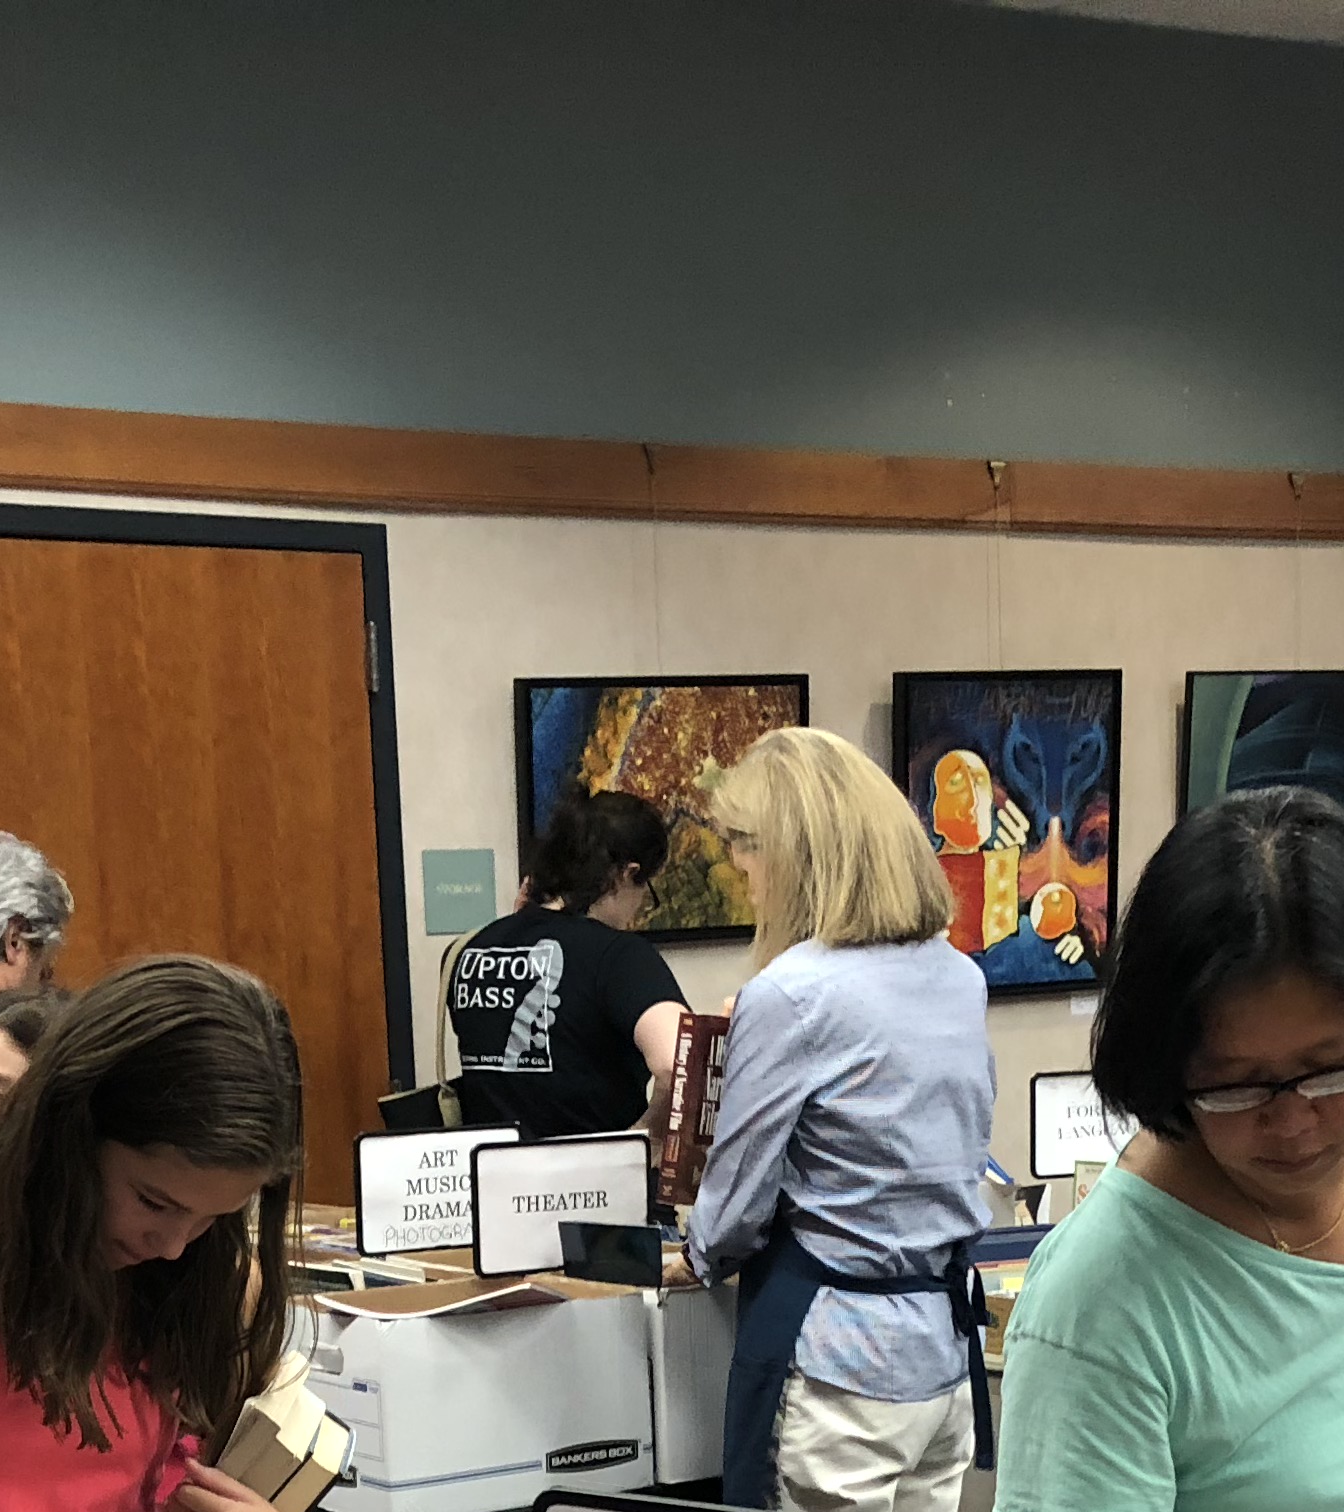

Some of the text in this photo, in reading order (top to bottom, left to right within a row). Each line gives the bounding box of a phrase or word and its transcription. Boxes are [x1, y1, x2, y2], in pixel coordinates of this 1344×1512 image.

[461, 952, 548, 981] UPTON
[457, 983, 515, 1010] BASS
[419, 1150, 458, 1170] ART
[406, 1175, 471, 1197] MUSIC
[403, 1201, 472, 1223] DRAMA
[512, 1190, 609, 1215] THEATER
[551, 1444, 634, 1468] BANKERS BOX
